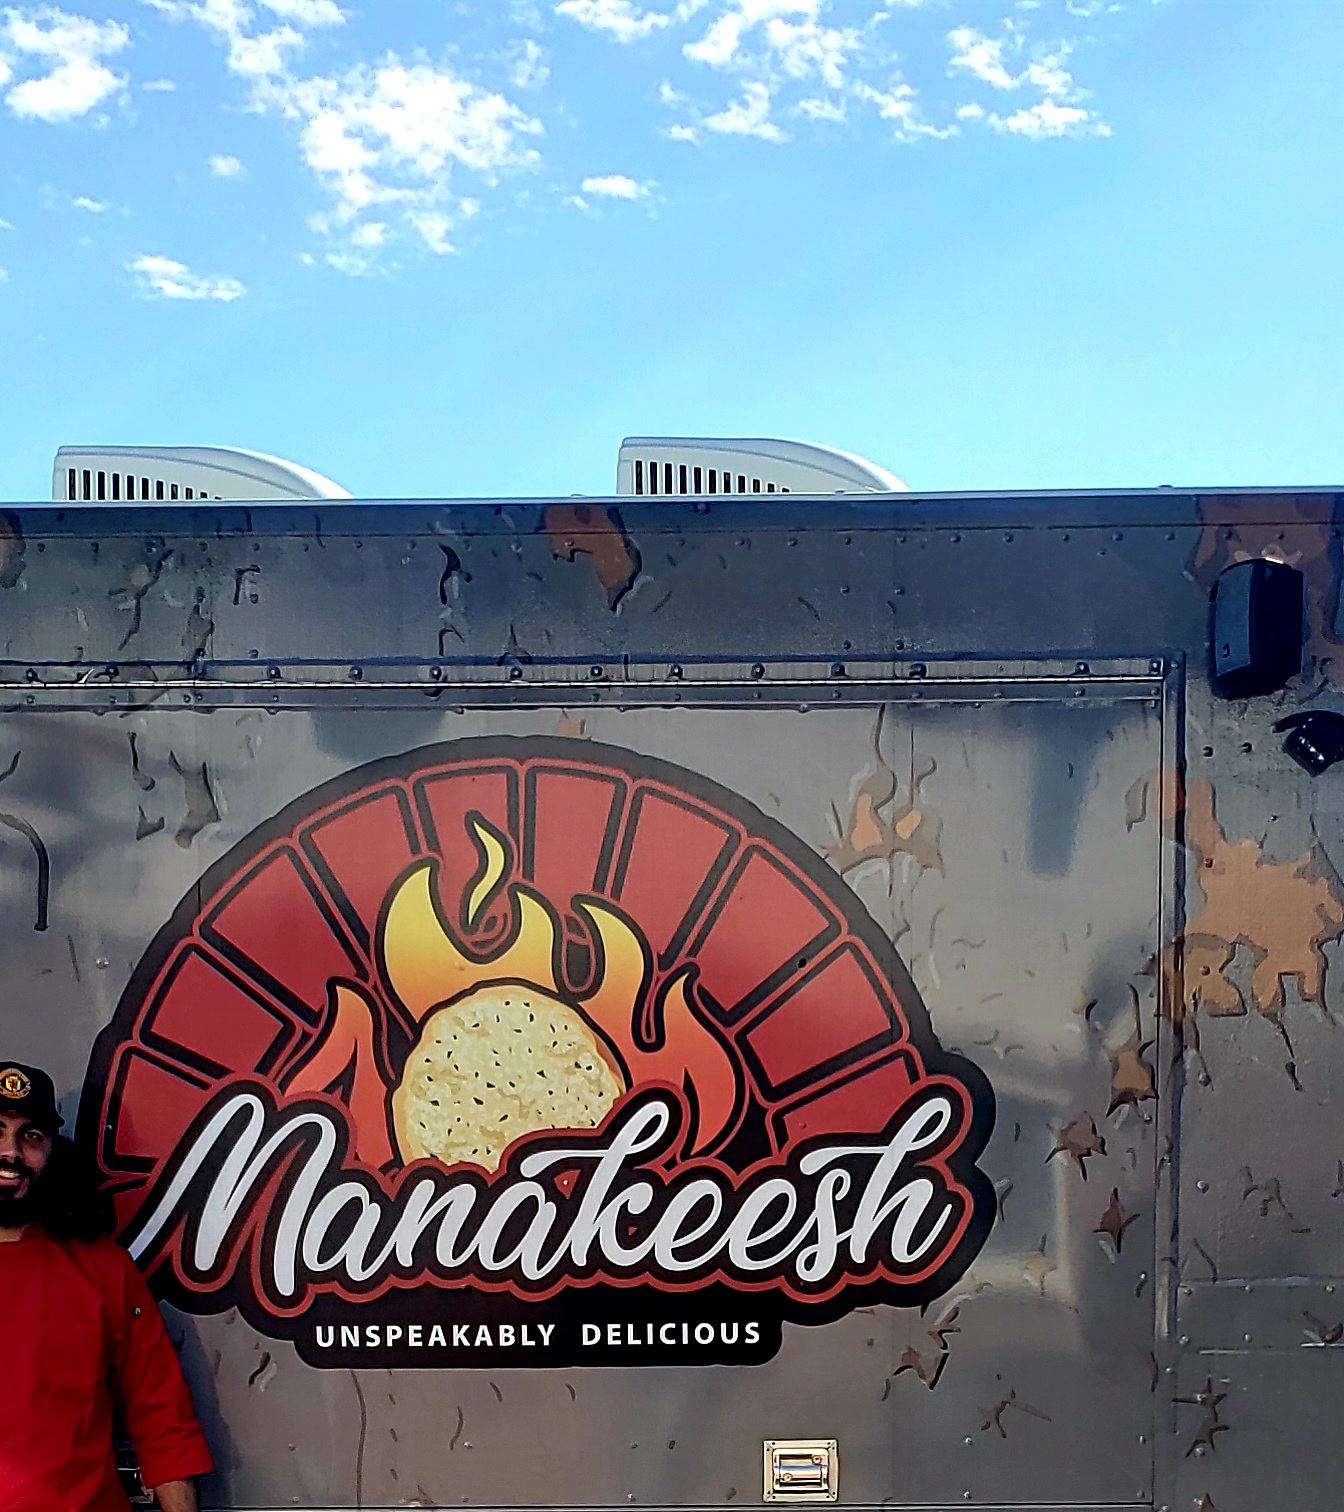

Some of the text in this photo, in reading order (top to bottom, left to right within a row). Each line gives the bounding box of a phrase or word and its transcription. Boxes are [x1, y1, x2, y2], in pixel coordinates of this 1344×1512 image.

[127, 1093, 952, 1298] Manakeesh
[315, 1322, 761, 1349] UNSPEAKABLY DELICIOUS
